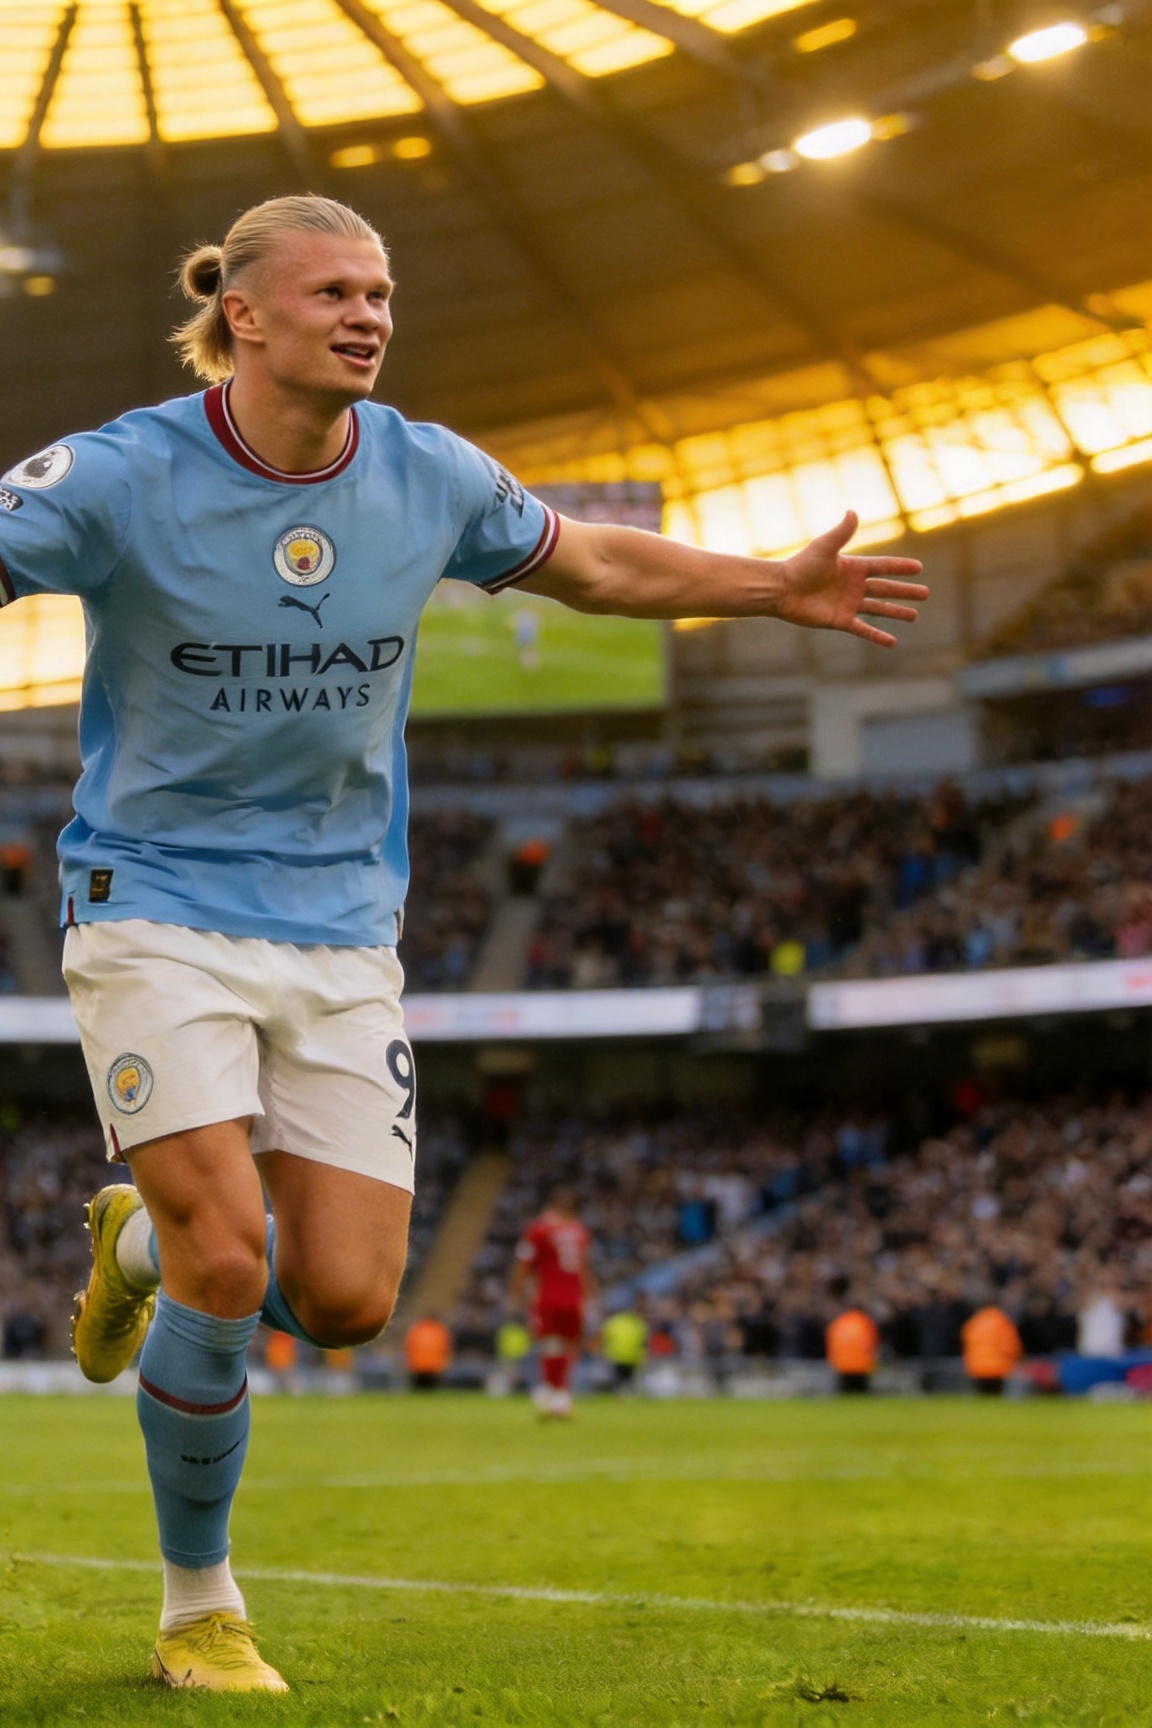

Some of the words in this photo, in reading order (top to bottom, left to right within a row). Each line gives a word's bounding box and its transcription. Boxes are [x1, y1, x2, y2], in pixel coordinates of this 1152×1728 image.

[170, 635, 405, 678] ETIHAD
[209, 683, 371, 713] AIRWAYS
[385, 1039, 415, 1119] 9
